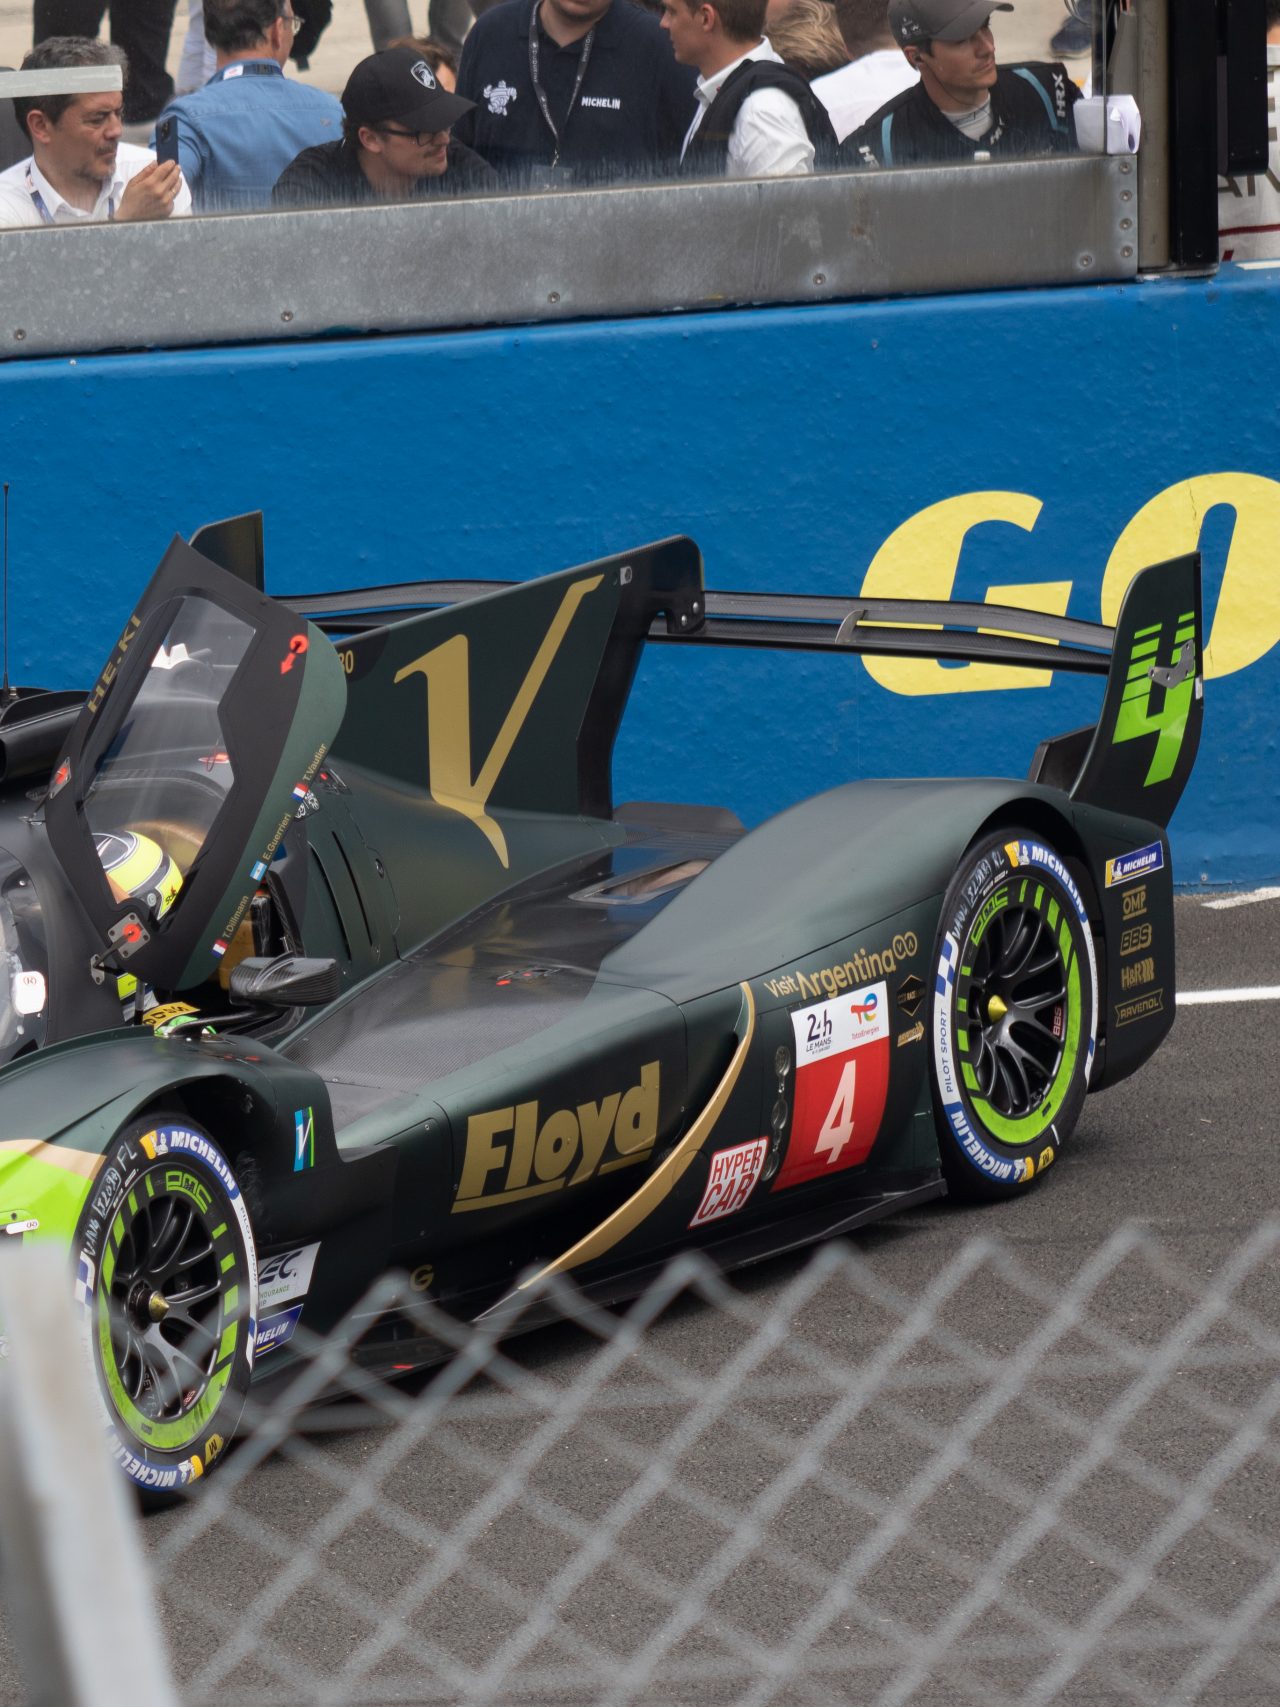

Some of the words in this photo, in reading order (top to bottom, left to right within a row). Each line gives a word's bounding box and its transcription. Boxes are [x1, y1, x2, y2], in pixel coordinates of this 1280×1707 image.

[582, 96, 620, 109] MICHELIN
[87, 615, 141, 713] HE.KI
[263, 813, 292, 861] E.Guerrieri
[1032, 846, 1084, 913] MICHELIN
[1123, 852, 1157, 872] MICHELIN
[222, 895, 249, 939] T.Dillmann
[1123, 893, 1147, 914] OMP
[1121, 925, 1151, 950] BBS
[764, 975, 799, 998] Visit
[796, 948, 897, 999] Argentina
[1053, 1007, 1062, 1036] BBS
[1121, 997, 1159, 1018] RAVENOL
[806, 1043, 814, 1052] LE
[814, 1037, 832, 1050] MANS
[943, 1059, 953, 1093] PILOT
[813, 1059, 857, 1165] 4
[451, 1059, 660, 1214] Floyd
[950, 1110, 1012, 1179] MICHELIN
[171, 1131, 236, 1191] MICHELIN
[712, 1147, 762, 1185] HYPER
[698, 1173, 754, 1219] CAR
[240, 1207, 252, 1240] PILOT
[259, 1250, 304, 1286] EC
[259, 1285, 290, 1299] NDURANCE
[257, 1321, 289, 1344] HELIN
